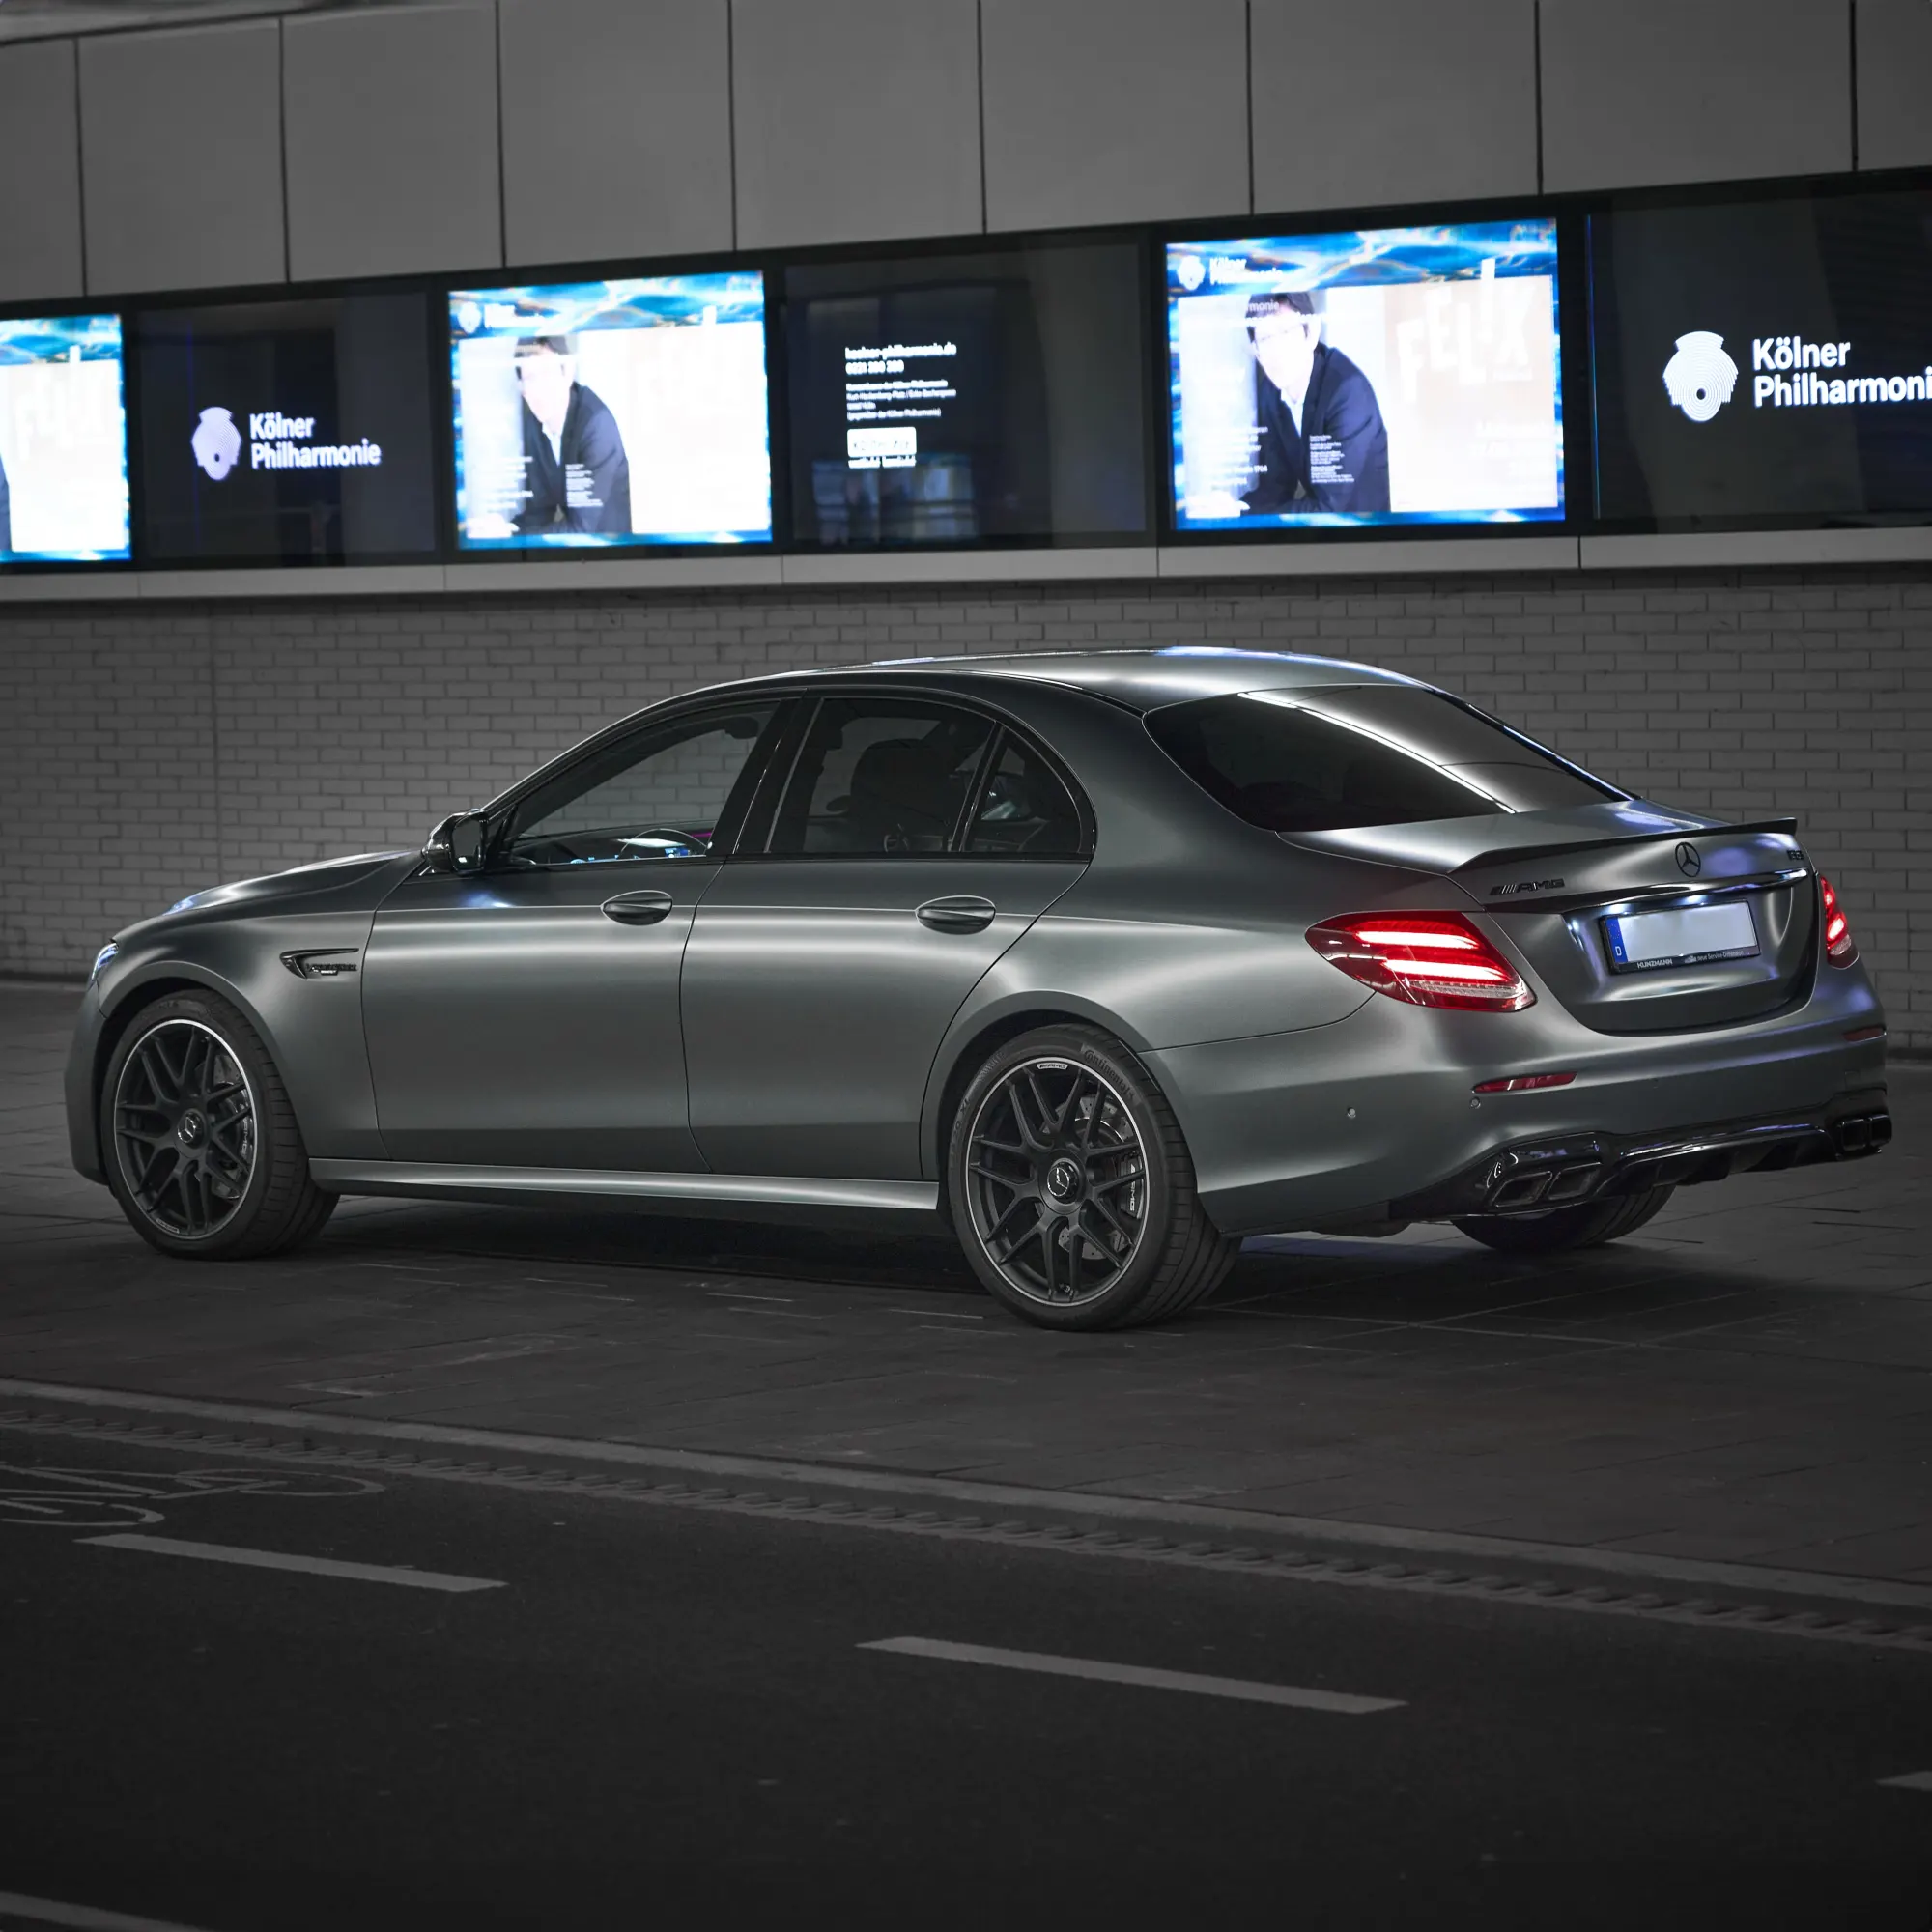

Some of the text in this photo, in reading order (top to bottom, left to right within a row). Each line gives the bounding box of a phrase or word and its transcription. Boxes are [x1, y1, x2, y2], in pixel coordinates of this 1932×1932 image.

[1753, 336, 1851, 370] Kölner
[1754, 366, 1932, 408] Philharmoni
[249, 412, 316, 440] Kölner
[251, 437, 382, 469] Philharmonie
[1516, 878, 1565, 893] AMG
[1614, 946, 1623, 956] D
[1636, 958, 1673, 969] KUNZMANN
